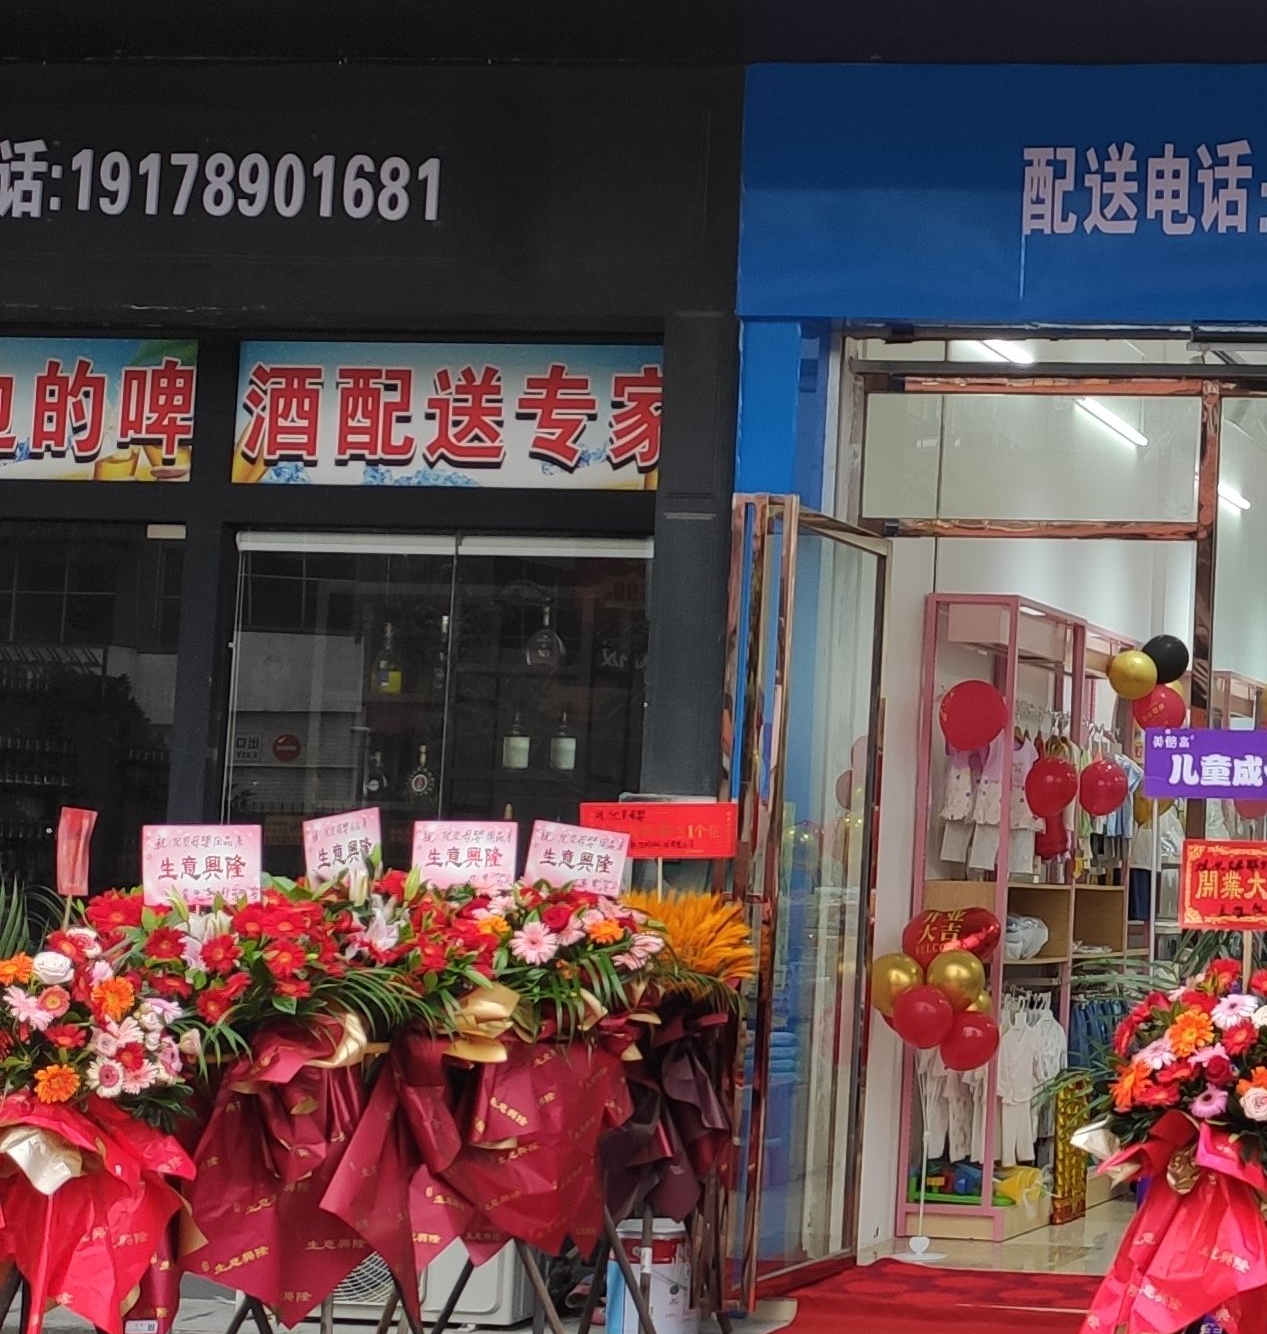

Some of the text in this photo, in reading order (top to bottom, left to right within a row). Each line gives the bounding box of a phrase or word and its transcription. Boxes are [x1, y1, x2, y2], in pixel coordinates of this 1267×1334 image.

[240, 363, 663, 469] 酒配送专家
